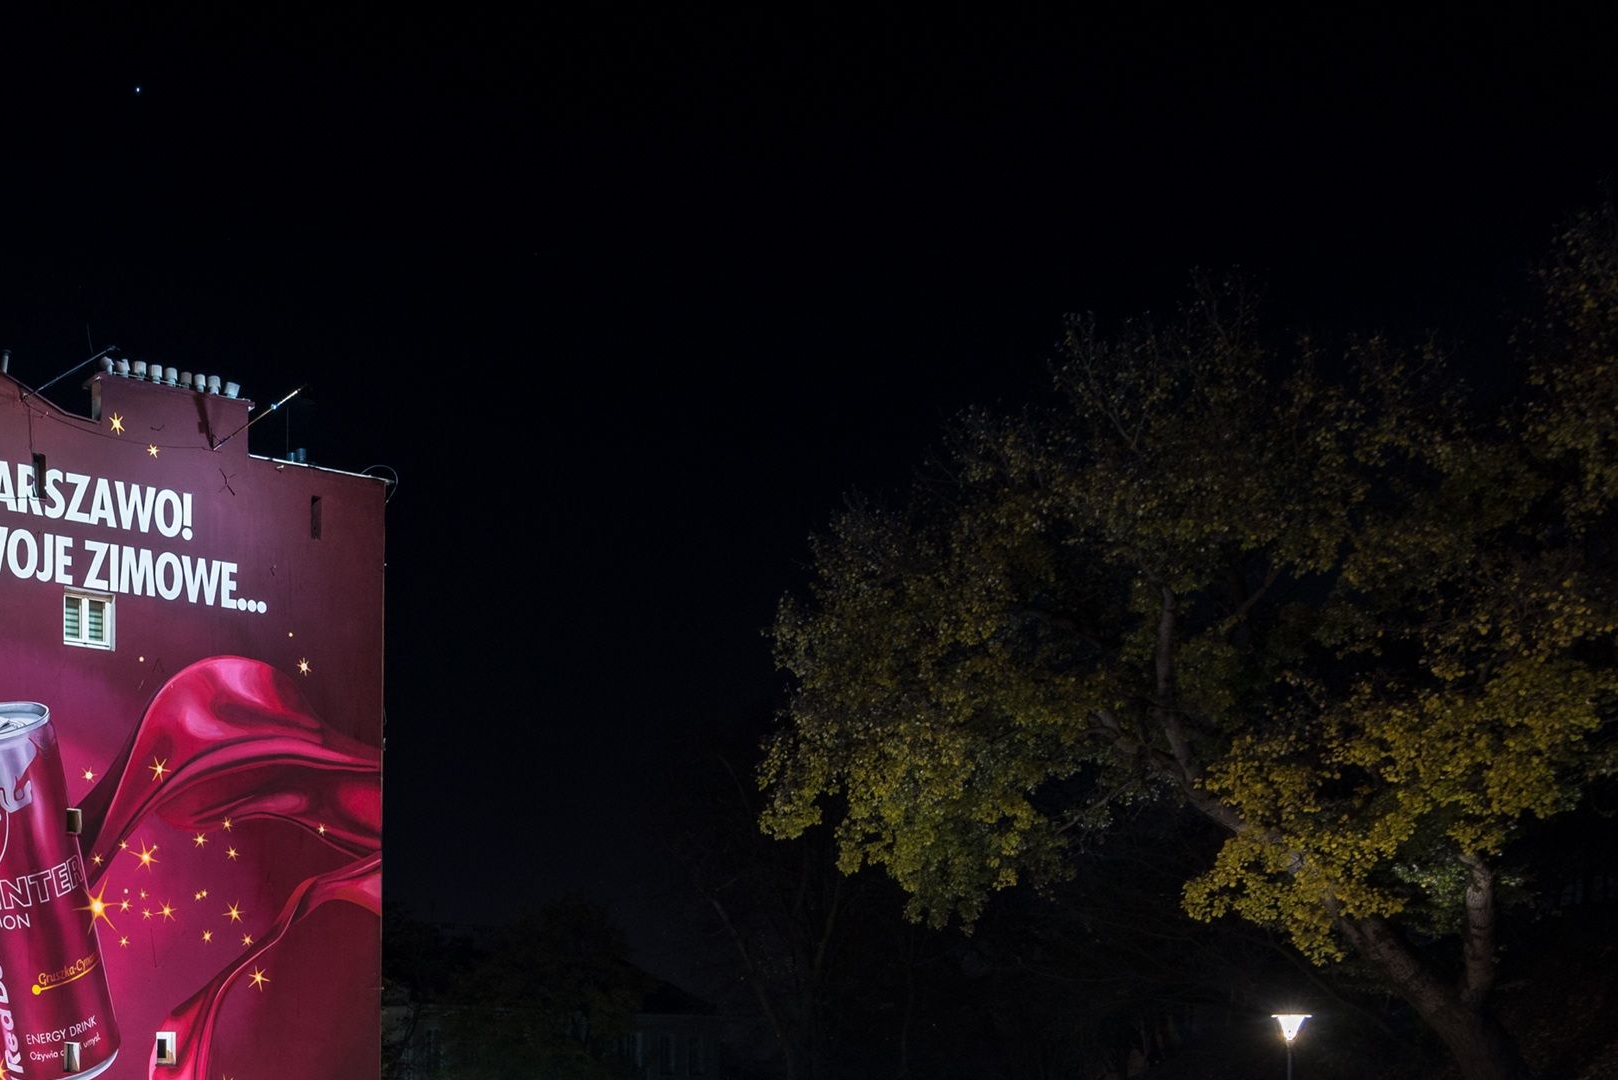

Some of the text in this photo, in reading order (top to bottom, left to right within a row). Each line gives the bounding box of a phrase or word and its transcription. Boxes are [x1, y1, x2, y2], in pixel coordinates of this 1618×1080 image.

[83, 540, 268, 614] ZIMOWE...
[26, 1014, 97, 1045] ENERGY DRINK
